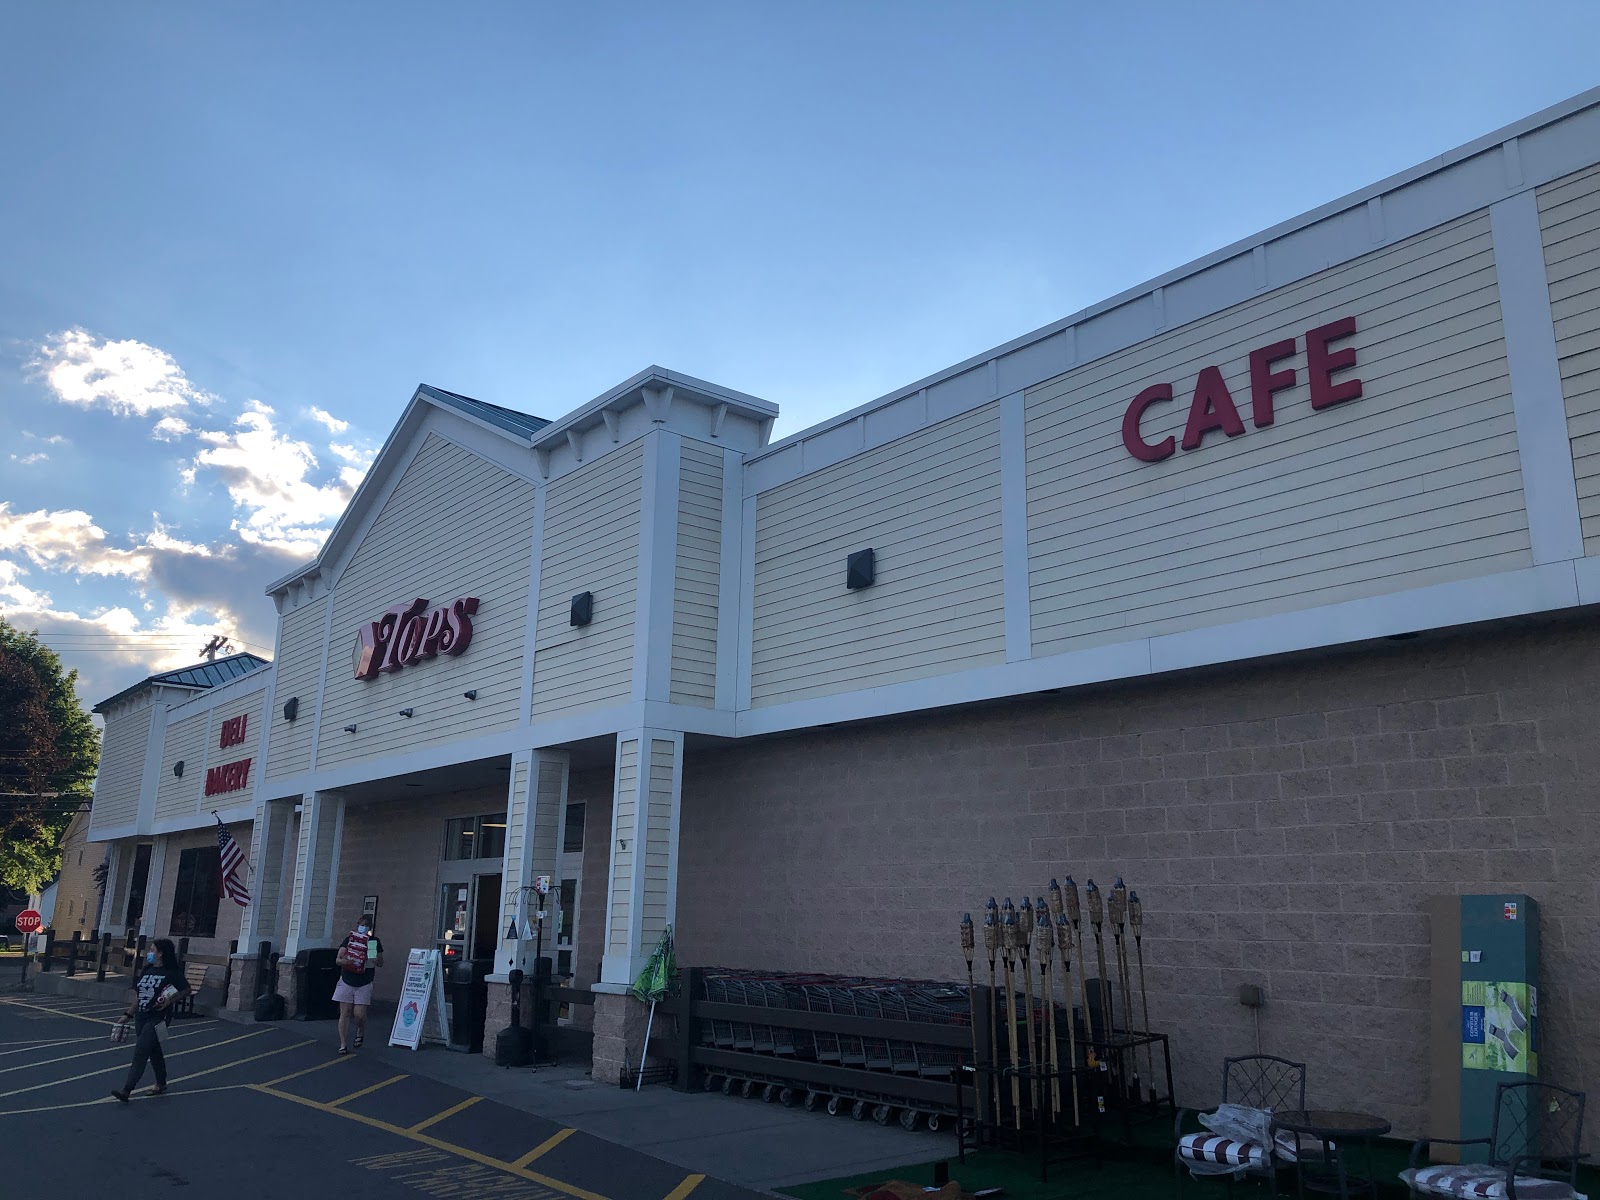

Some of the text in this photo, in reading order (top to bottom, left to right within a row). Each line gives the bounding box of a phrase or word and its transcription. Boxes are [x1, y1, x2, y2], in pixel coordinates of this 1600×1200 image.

[1121, 316, 1363, 463] CAFE
[220, 714, 248, 750] DELI
[205, 758, 252, 797] BAKERY
[17, 916, 41, 926] STOP
[347, 1147, 451, 1170] NO
